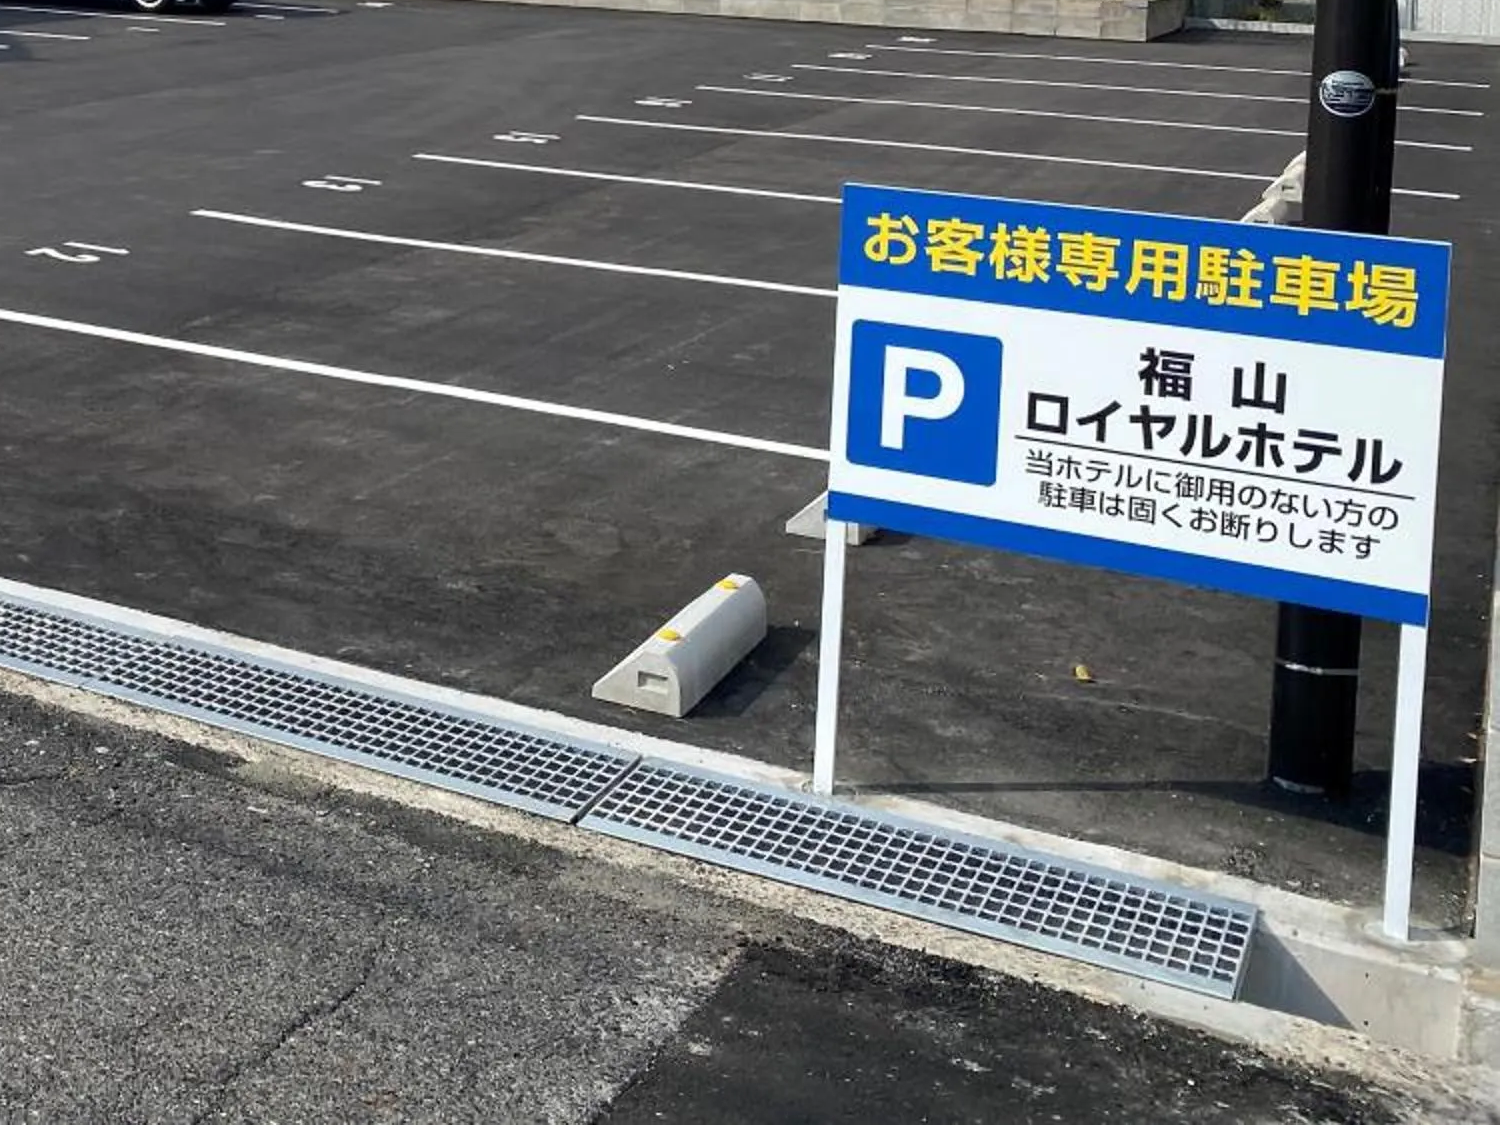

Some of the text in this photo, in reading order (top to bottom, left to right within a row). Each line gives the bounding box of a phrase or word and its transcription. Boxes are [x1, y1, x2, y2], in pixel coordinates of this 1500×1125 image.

[23, 241, 131, 263] 12
[863, 213, 1418, 328] お客様専用駐車場
[881, 345, 965, 450] P
[1027, 391, 1403, 484] ロイヤルホテル
[1025, 449, 1399, 532] 当ホテルに御用のない方の
[1037, 479, 1381, 561] 駐車は固くお断りします
